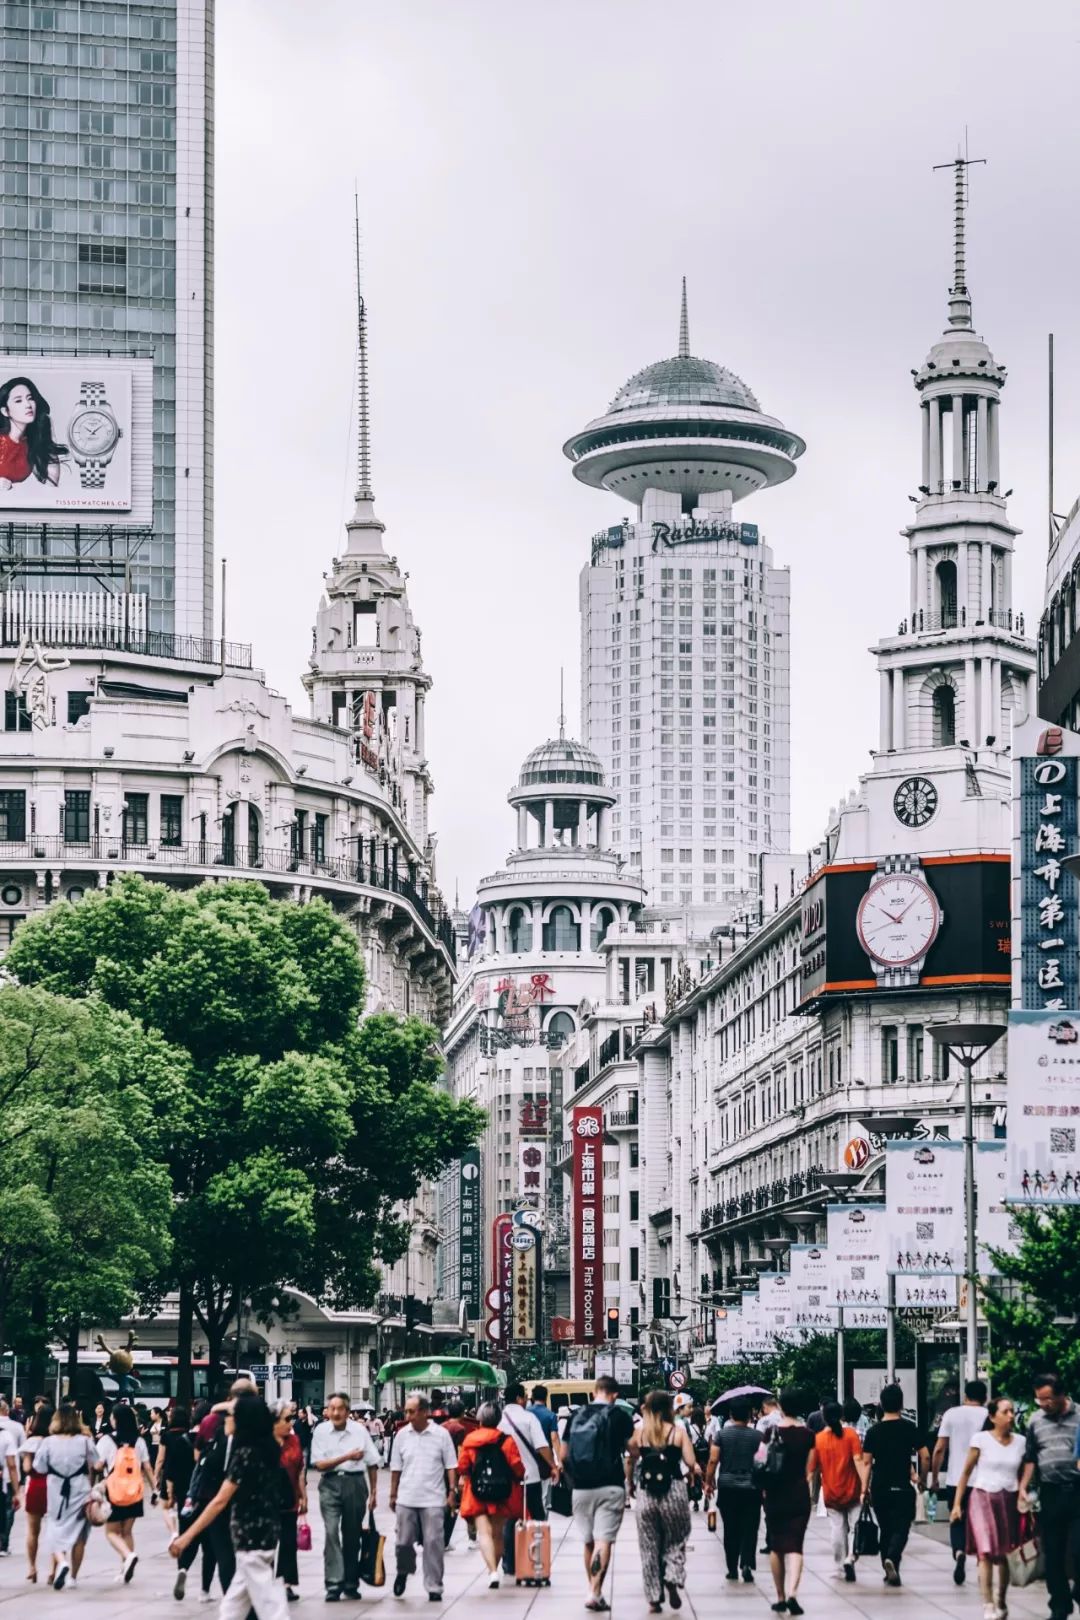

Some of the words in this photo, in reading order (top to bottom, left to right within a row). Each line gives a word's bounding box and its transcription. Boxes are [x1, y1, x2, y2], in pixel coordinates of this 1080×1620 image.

[55, 499, 128, 507] TISSOTWATCHES.CN
[651, 516, 739, 552] Radisson
[581, 1142, 596, 1260] 上海市第一食品商店
[461, 1184, 473, 1305] 上海市第一百货商店
[584, 1266, 594, 1287] First
[584, 1289, 594, 1336] Foodhall
